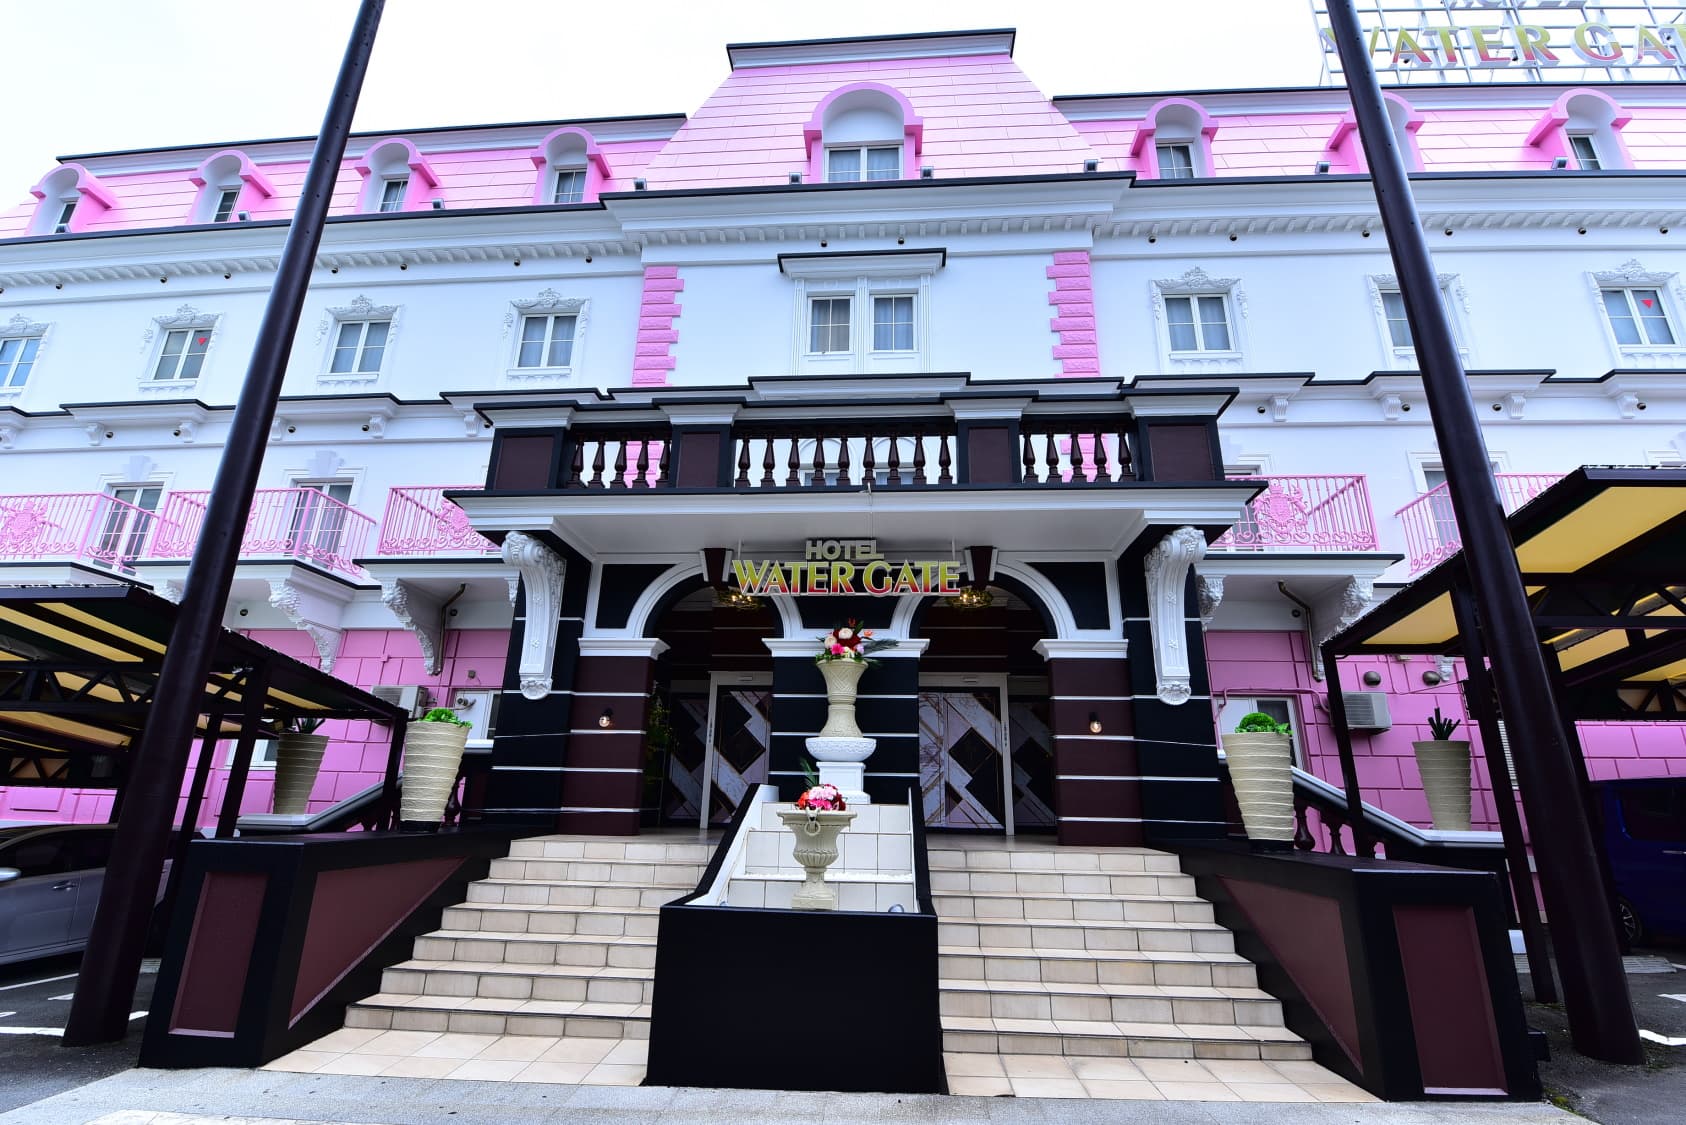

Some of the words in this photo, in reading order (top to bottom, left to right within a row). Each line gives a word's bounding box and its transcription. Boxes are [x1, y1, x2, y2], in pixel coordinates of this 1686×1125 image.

[805, 539, 884, 561] HOTEL
[731, 559, 856, 597] WATER
[861, 559, 961, 598] GATE
